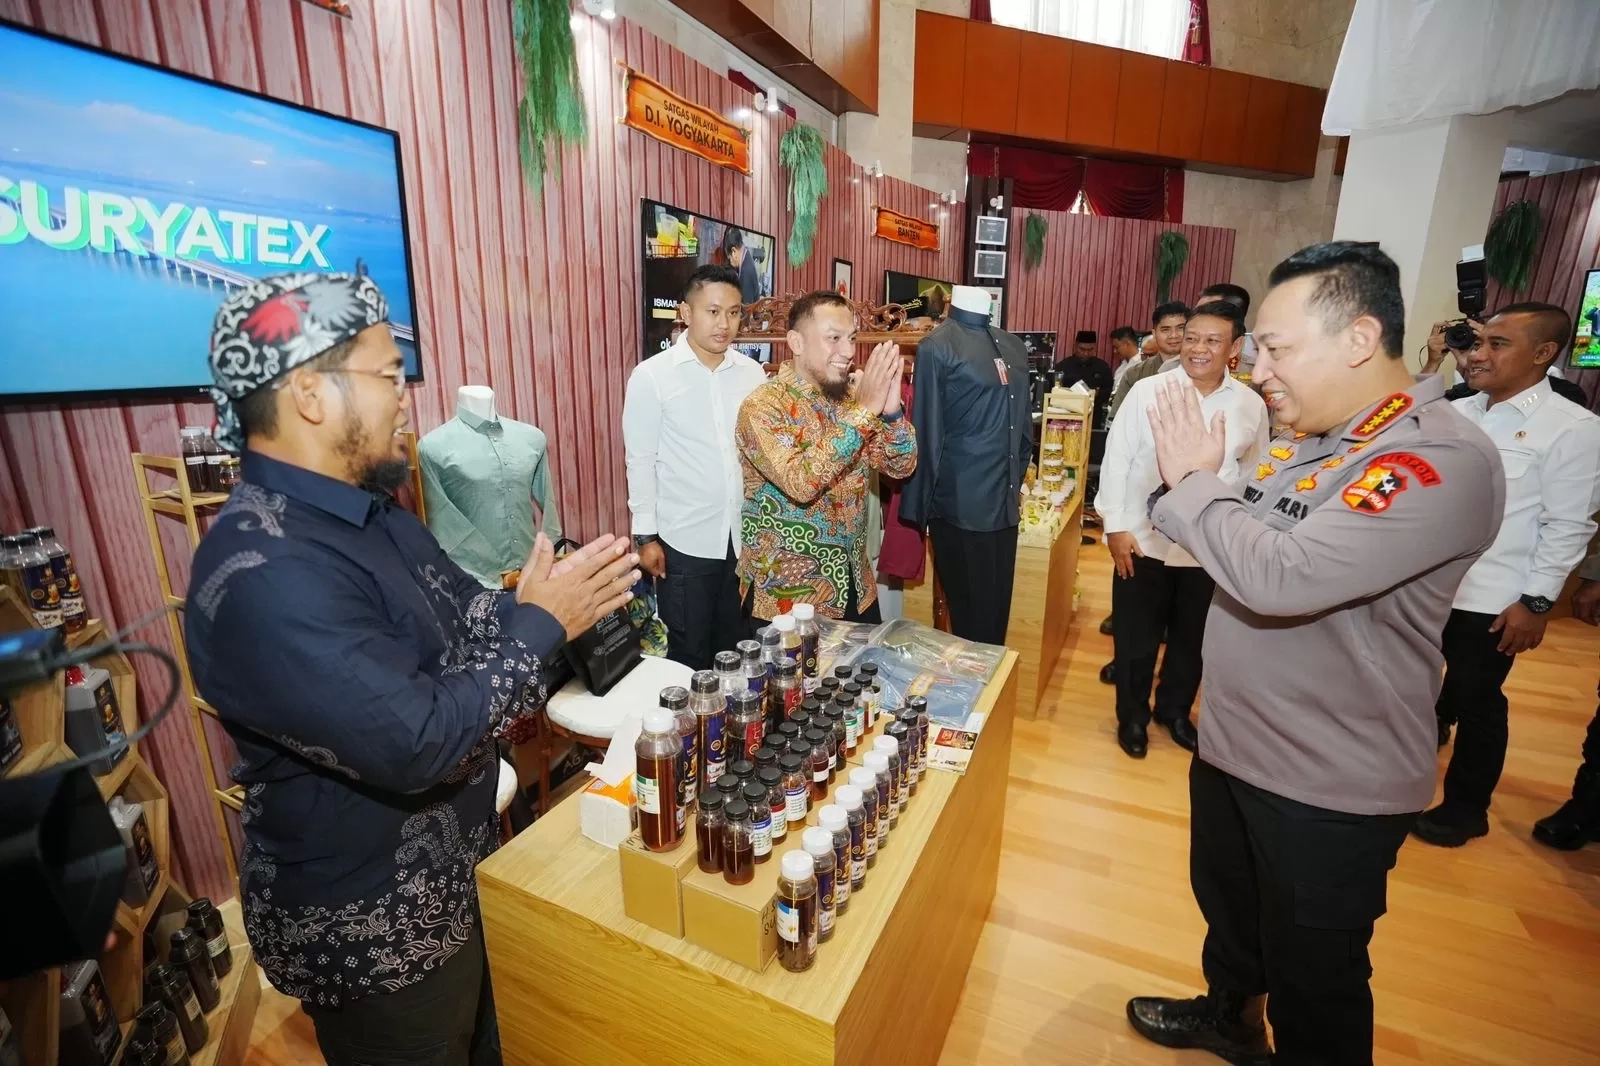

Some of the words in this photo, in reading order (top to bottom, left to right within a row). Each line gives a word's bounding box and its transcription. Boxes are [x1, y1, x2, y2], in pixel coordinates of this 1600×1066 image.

[644, 104, 664, 129] D.I.
[666, 115, 735, 158] YOGYAKARTA
[663, 100, 690, 121] SATGAS
[690, 113, 719, 135] WILAYAH
[897, 226, 920, 240] BANTEN
